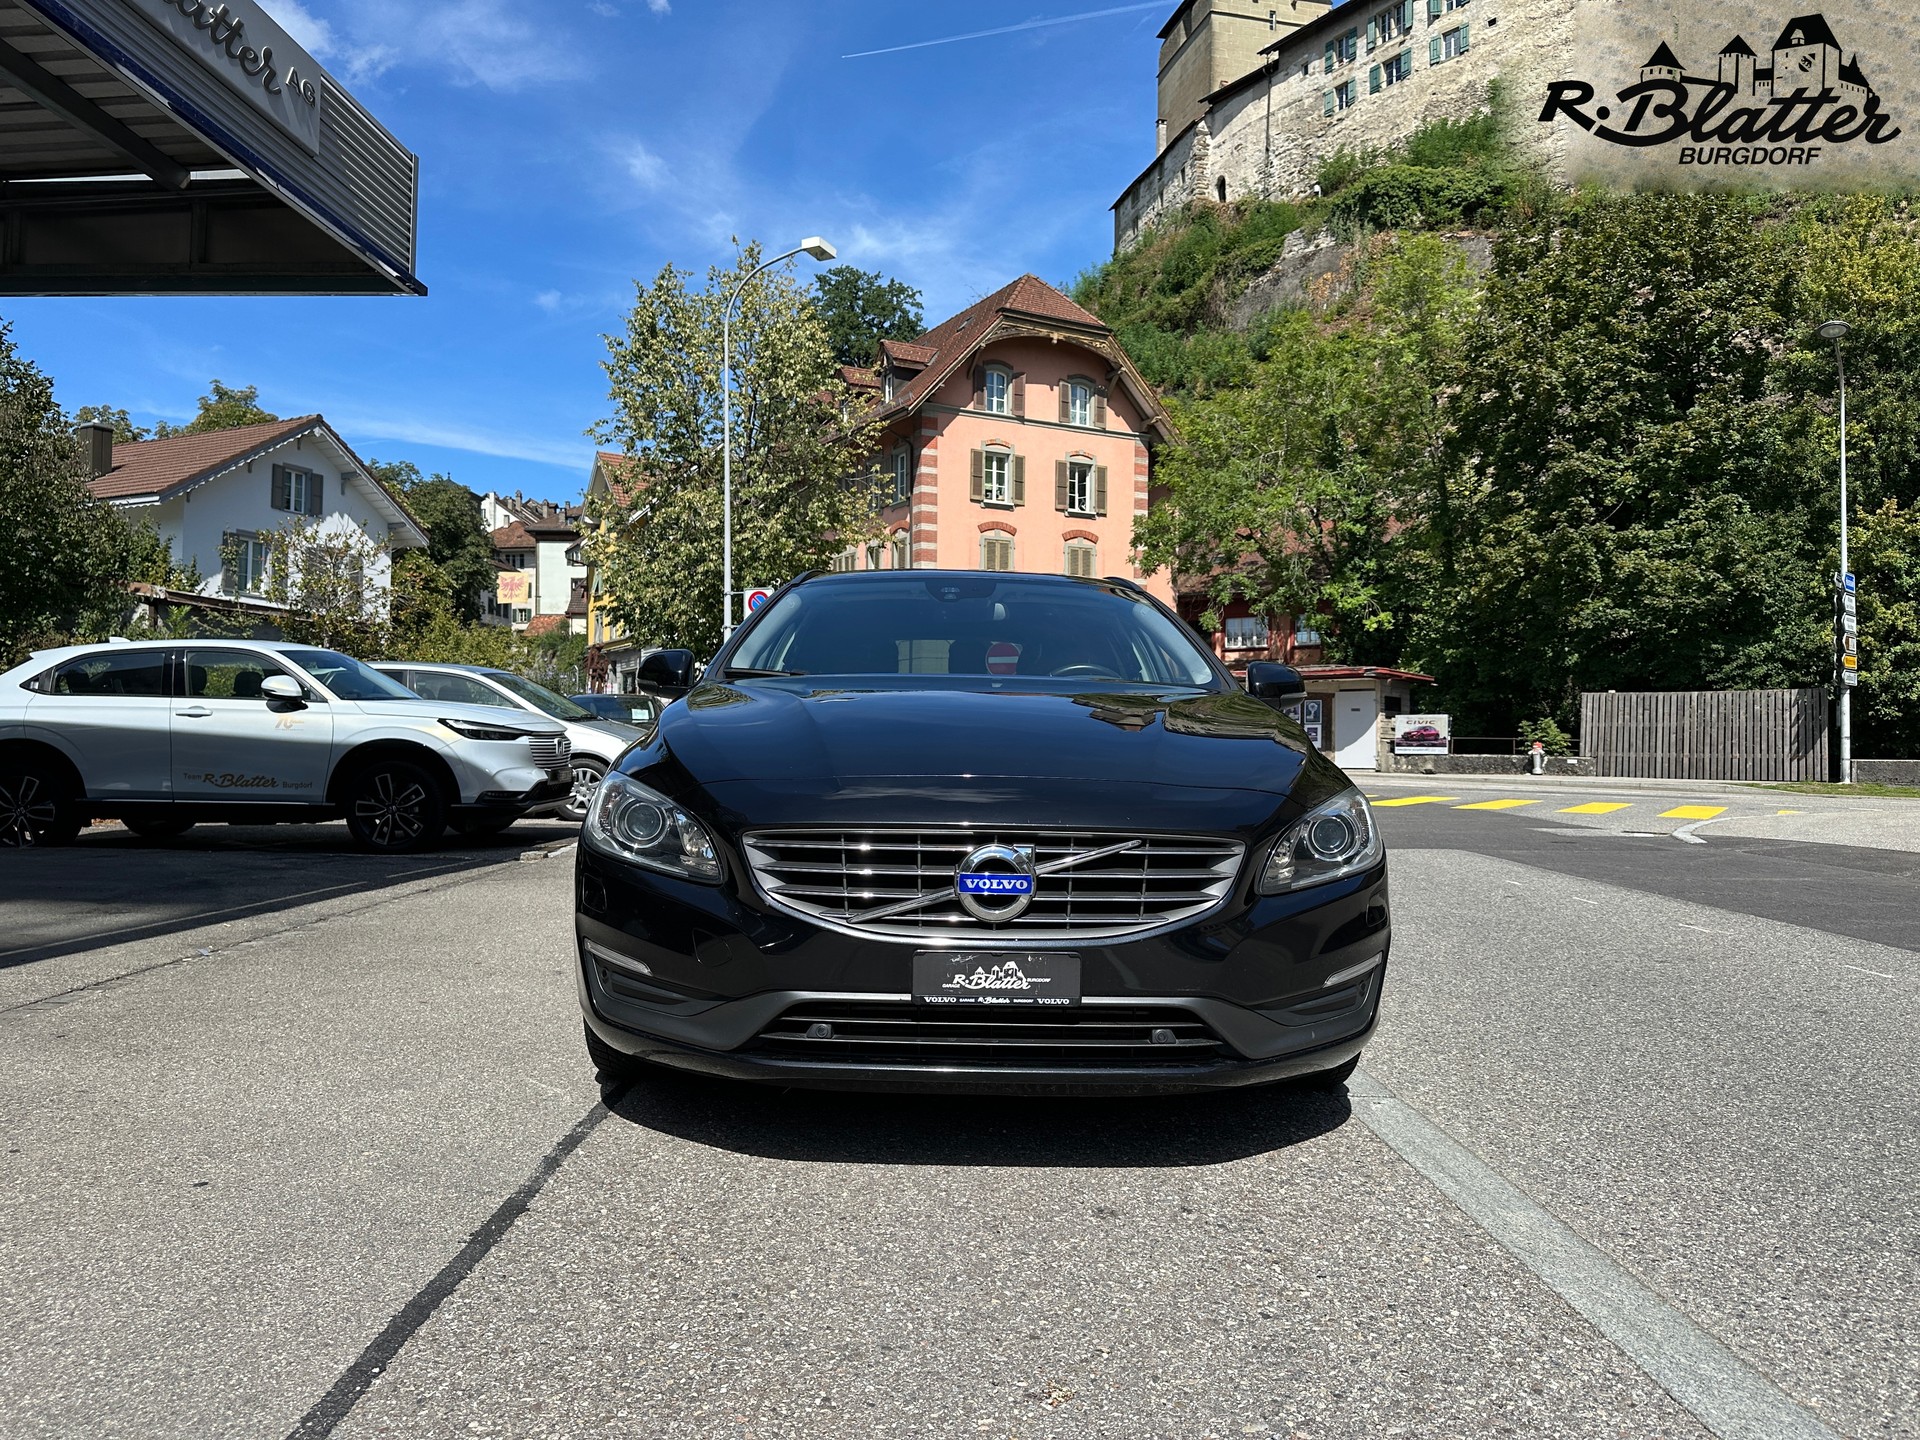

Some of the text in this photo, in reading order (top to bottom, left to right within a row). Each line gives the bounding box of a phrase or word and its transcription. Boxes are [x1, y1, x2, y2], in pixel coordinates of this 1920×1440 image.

[164, 0, 316, 108] atter AG
[282, 782, 313, 790] Burgdorf
[963, 878, 1028, 890] VOLVO
